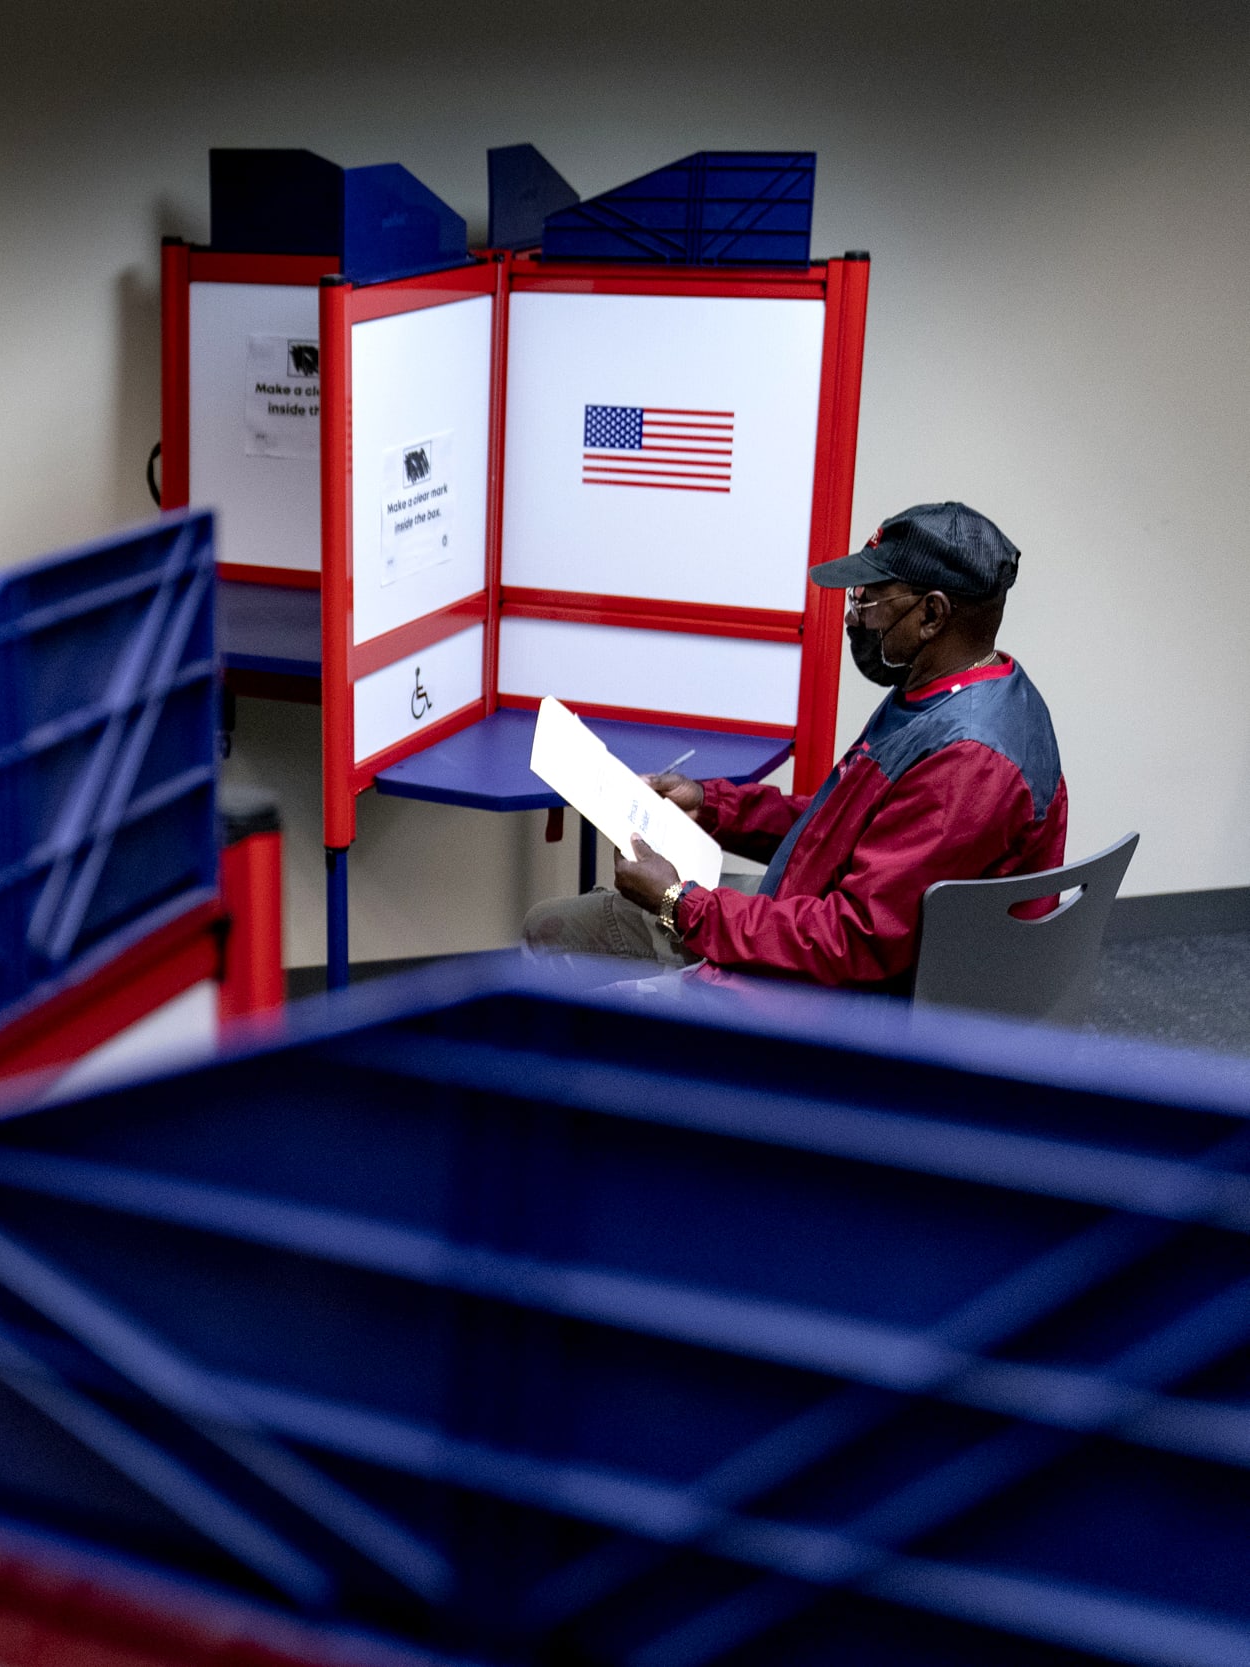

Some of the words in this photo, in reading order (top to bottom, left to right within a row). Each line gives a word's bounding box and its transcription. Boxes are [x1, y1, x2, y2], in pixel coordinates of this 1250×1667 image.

[255, 382, 291, 396] Make
[294, 386, 302, 396] a
[268, 401, 306, 417] inside
[387, 499, 407, 515] Make
[407, 498, 413, 508] a
[413, 492, 430, 505] clear
[430, 482, 448, 498] mark
[394, 516, 414, 535] inside
[414, 512, 426, 525] the
